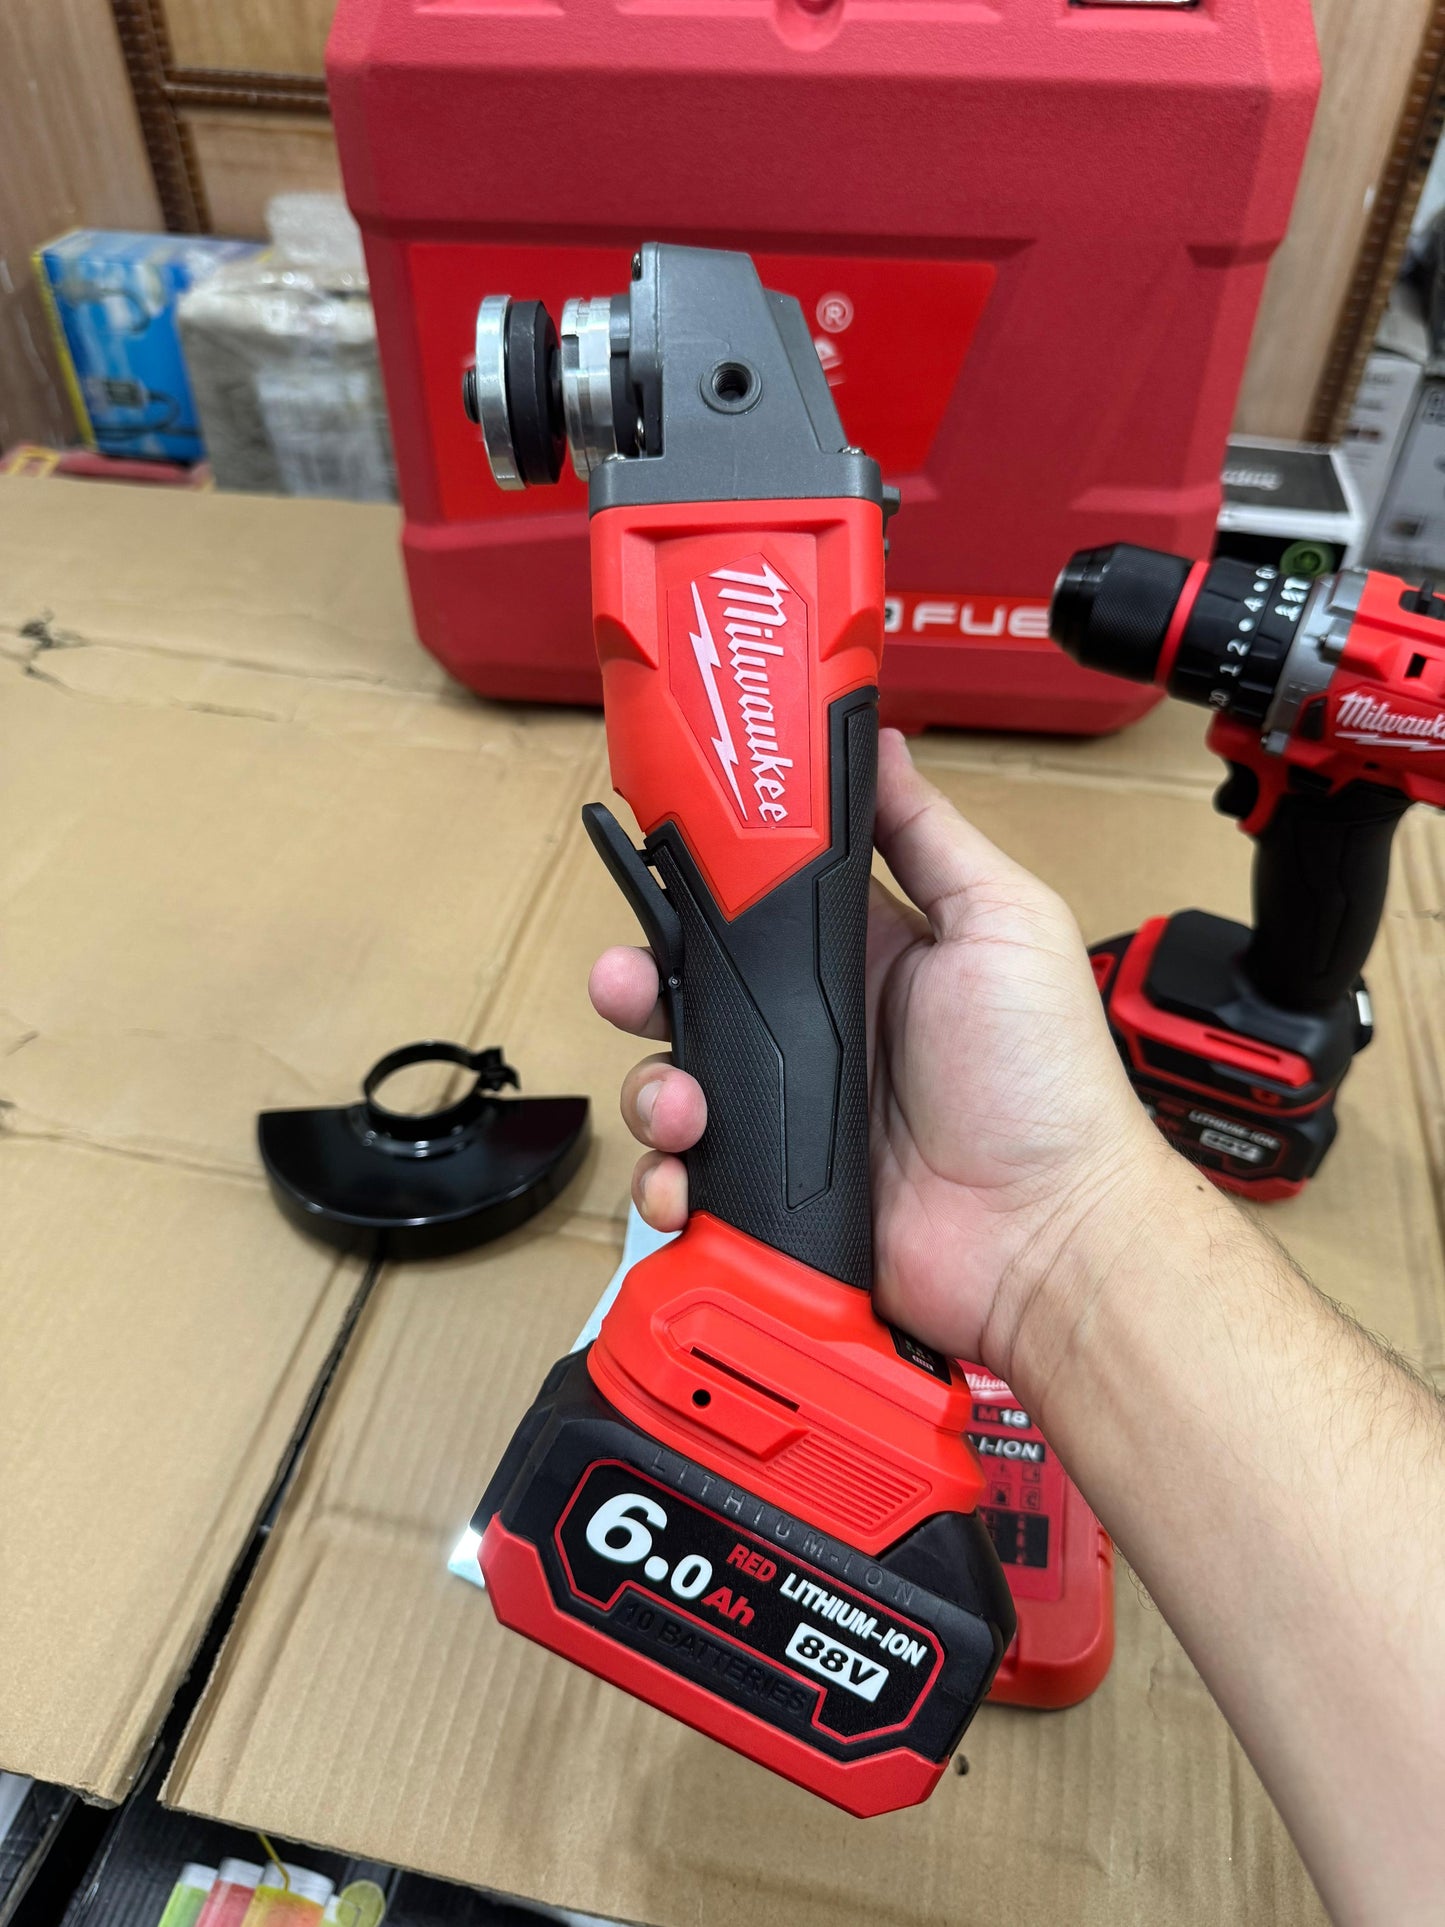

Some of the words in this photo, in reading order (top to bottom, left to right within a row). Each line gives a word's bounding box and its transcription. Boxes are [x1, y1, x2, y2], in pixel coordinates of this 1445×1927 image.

[912, 602, 1051, 638] FUE
[1244, 596, 1265, 612] 4
[1227, 638, 1250, 656] 2
[1219, 663, 1243, 677] 1
[709, 563, 793, 822] Milwaukee
[1336, 690, 1445, 740] Milwauk
[977, 1407, 1031, 1429] M18
[967, 1434, 1041, 1462] I-ION
[651, 1449, 914, 1606] LITHIUM-ION
[726, 1543, 778, 1582] RED
[779, 1572, 928, 1668] LITHIUM-ION
[656, 1619, 808, 1715] BATTERIES
[796, 1634, 880, 1686] 88V
